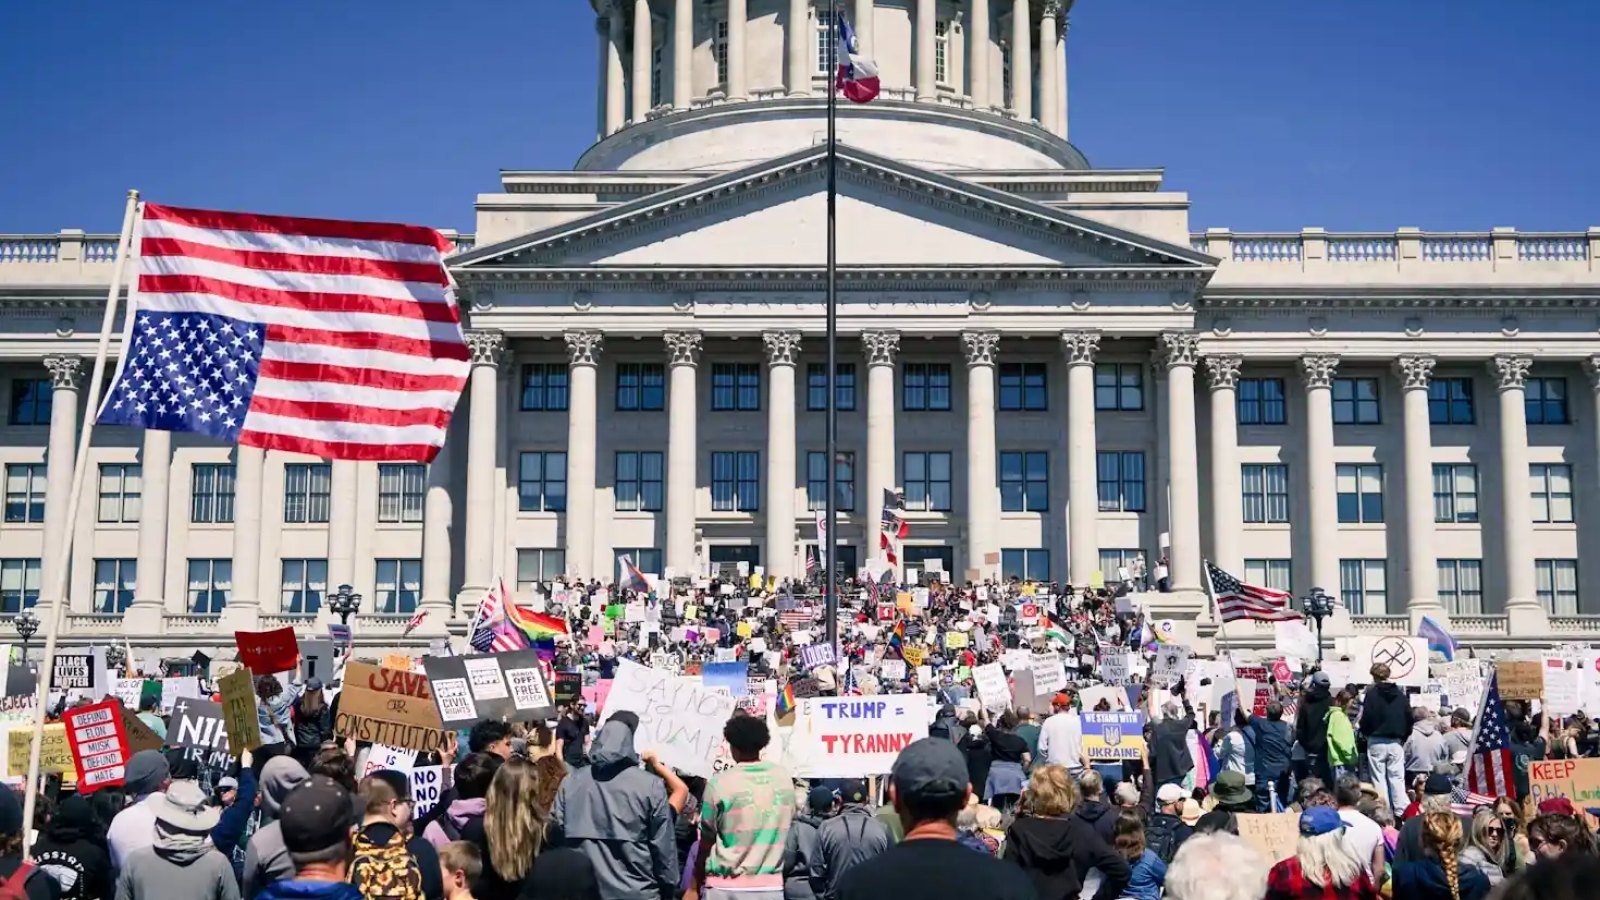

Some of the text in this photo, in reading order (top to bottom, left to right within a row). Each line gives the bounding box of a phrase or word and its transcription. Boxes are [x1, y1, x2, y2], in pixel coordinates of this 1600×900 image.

[56, 656, 87, 666] BLACK
[802, 643, 836, 668] LOUDER
[1104, 657, 1121, 666] WILL
[59, 667, 84, 676] LIVES
[1110, 668, 1128, 677] NOT
[368, 668, 430, 699] SAVE
[514, 684, 541, 696] FREE
[443, 697, 469, 708] CIVIL
[821, 701, 886, 718] TRUMP
[895, 707, 904, 715] =
[76, 710, 108, 725] DEFUND
[85, 726, 106, 739] ELON
[335, 712, 454, 754] CONSTITUTION
[87, 740, 110, 753] MUSK
[821, 733, 913, 753] TYRANNY
[1087, 747, 1140, 757] UKRAINE
[86, 753, 117, 768] DEFUND
[386, 755, 396, 765] IS
[1533, 760, 1576, 780] KEEP
[414, 770, 436, 785] NO
[416, 787, 437, 801] NO
